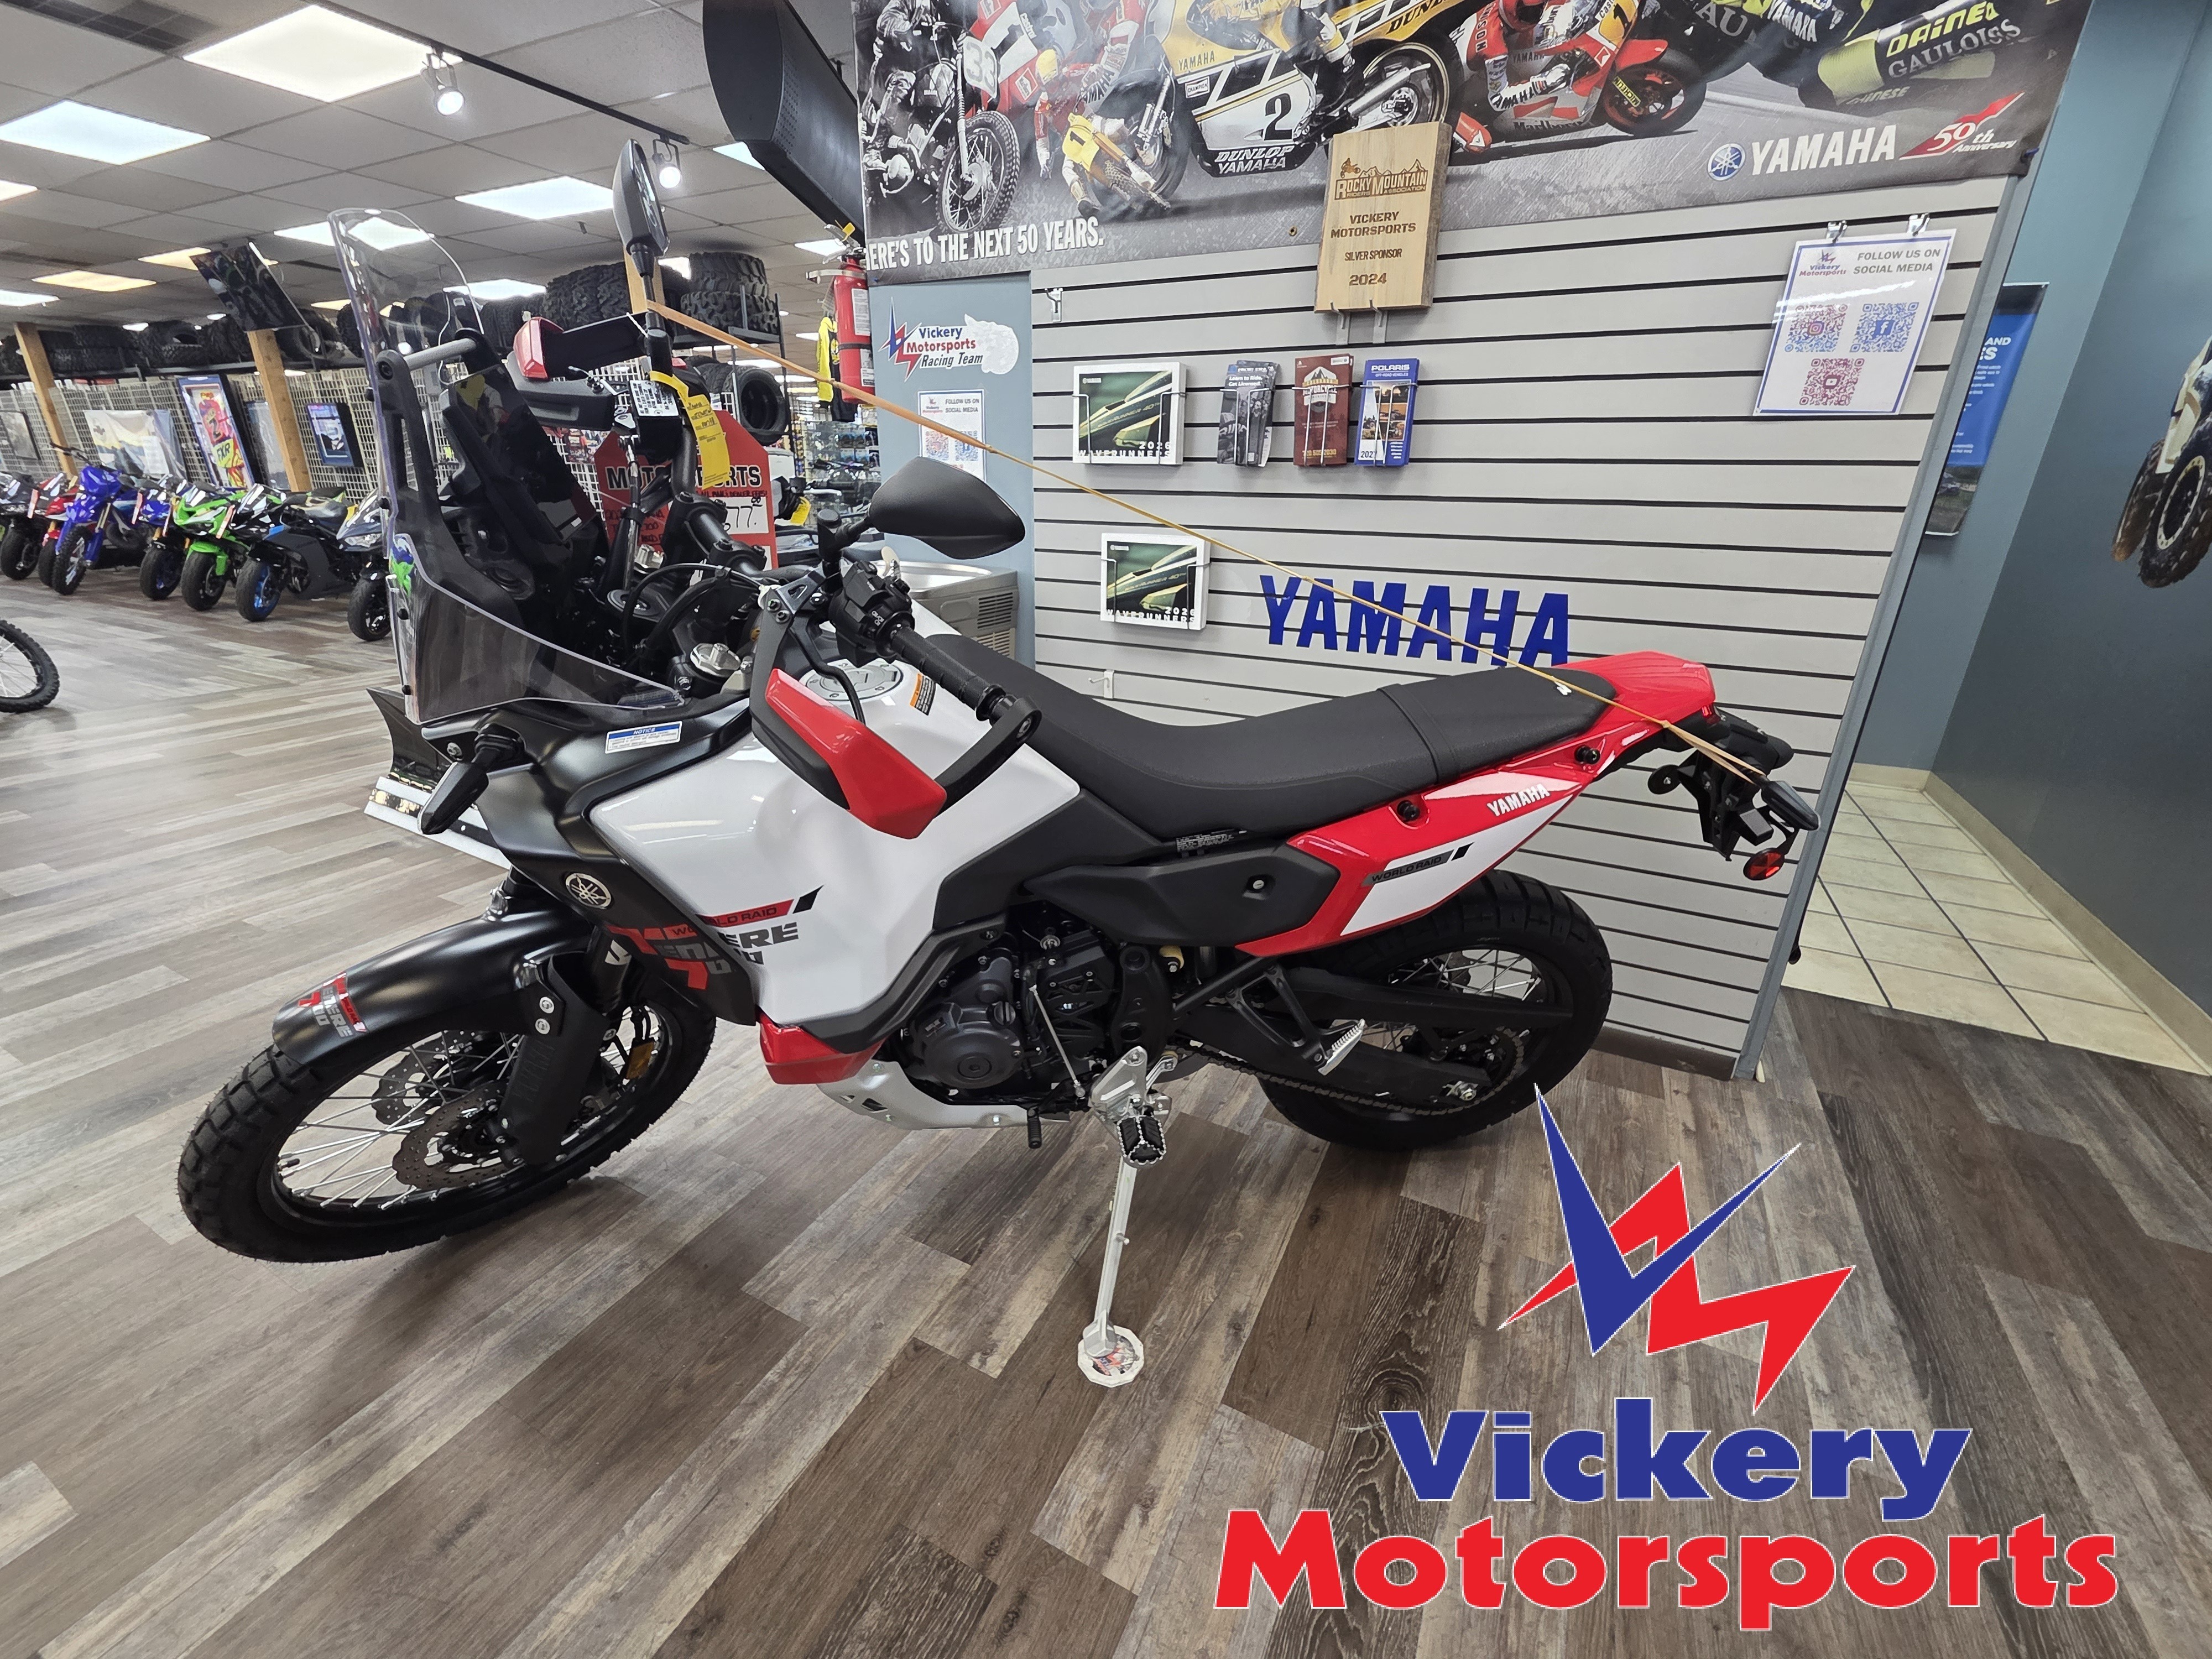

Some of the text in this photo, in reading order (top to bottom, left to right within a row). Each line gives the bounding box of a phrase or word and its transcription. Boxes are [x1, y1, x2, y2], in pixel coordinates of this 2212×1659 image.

[1178, 51, 1215, 71] YAMAHA
[1187, 82, 1209, 93] CHAMPION
[1615, 77, 1640, 106] MICHELIN
[1264, 93, 1293, 140] 2
[1214, 145, 1295, 163] DUNLOP
[1752, 125, 1897, 176] YAMAHA
[1953, 139, 2017, 154] Anniversary
[1217, 156, 1287, 175] YAMAHA
[1335, 170, 1428, 199] ROCKY MOUNTAIN
[1350, 211, 1400, 224] VICKERY
[1331, 223, 1417, 238] MOTORSPORTS
[914, 236, 934, 265] TO
[938, 232, 969, 263] THE
[973, 226, 1014, 259] NEXT
[1018, 223, 1039, 254] 50
[1043, 216, 1105, 252] YEARS.
[1344, 248, 1402, 262] SILVER SPONSOR
[1857, 248, 1940, 261] FOLLOW US ON
[1799, 269, 1847, 277] Motorsports
[1853, 263, 1933, 274] SOCIAL MEDIA
[1349, 273, 1387, 286] 2024
[919, 327, 963, 340] Vickery
[906, 338, 976, 353] Motorsports
[1985, 337, 2011, 346] AND
[921, 352, 983, 367] Racing Team
[1139, 441, 1171, 450] 2026
[216, 442, 231, 465] FXR
[1164, 606, 1195, 616] 2026
[1260, 575, 1568, 667] YAMAHA
[1486, 783, 1550, 817] YAMAHA
[1371, 856, 1442, 882] WORLD RAID
[740, 906, 778, 921] RAID
